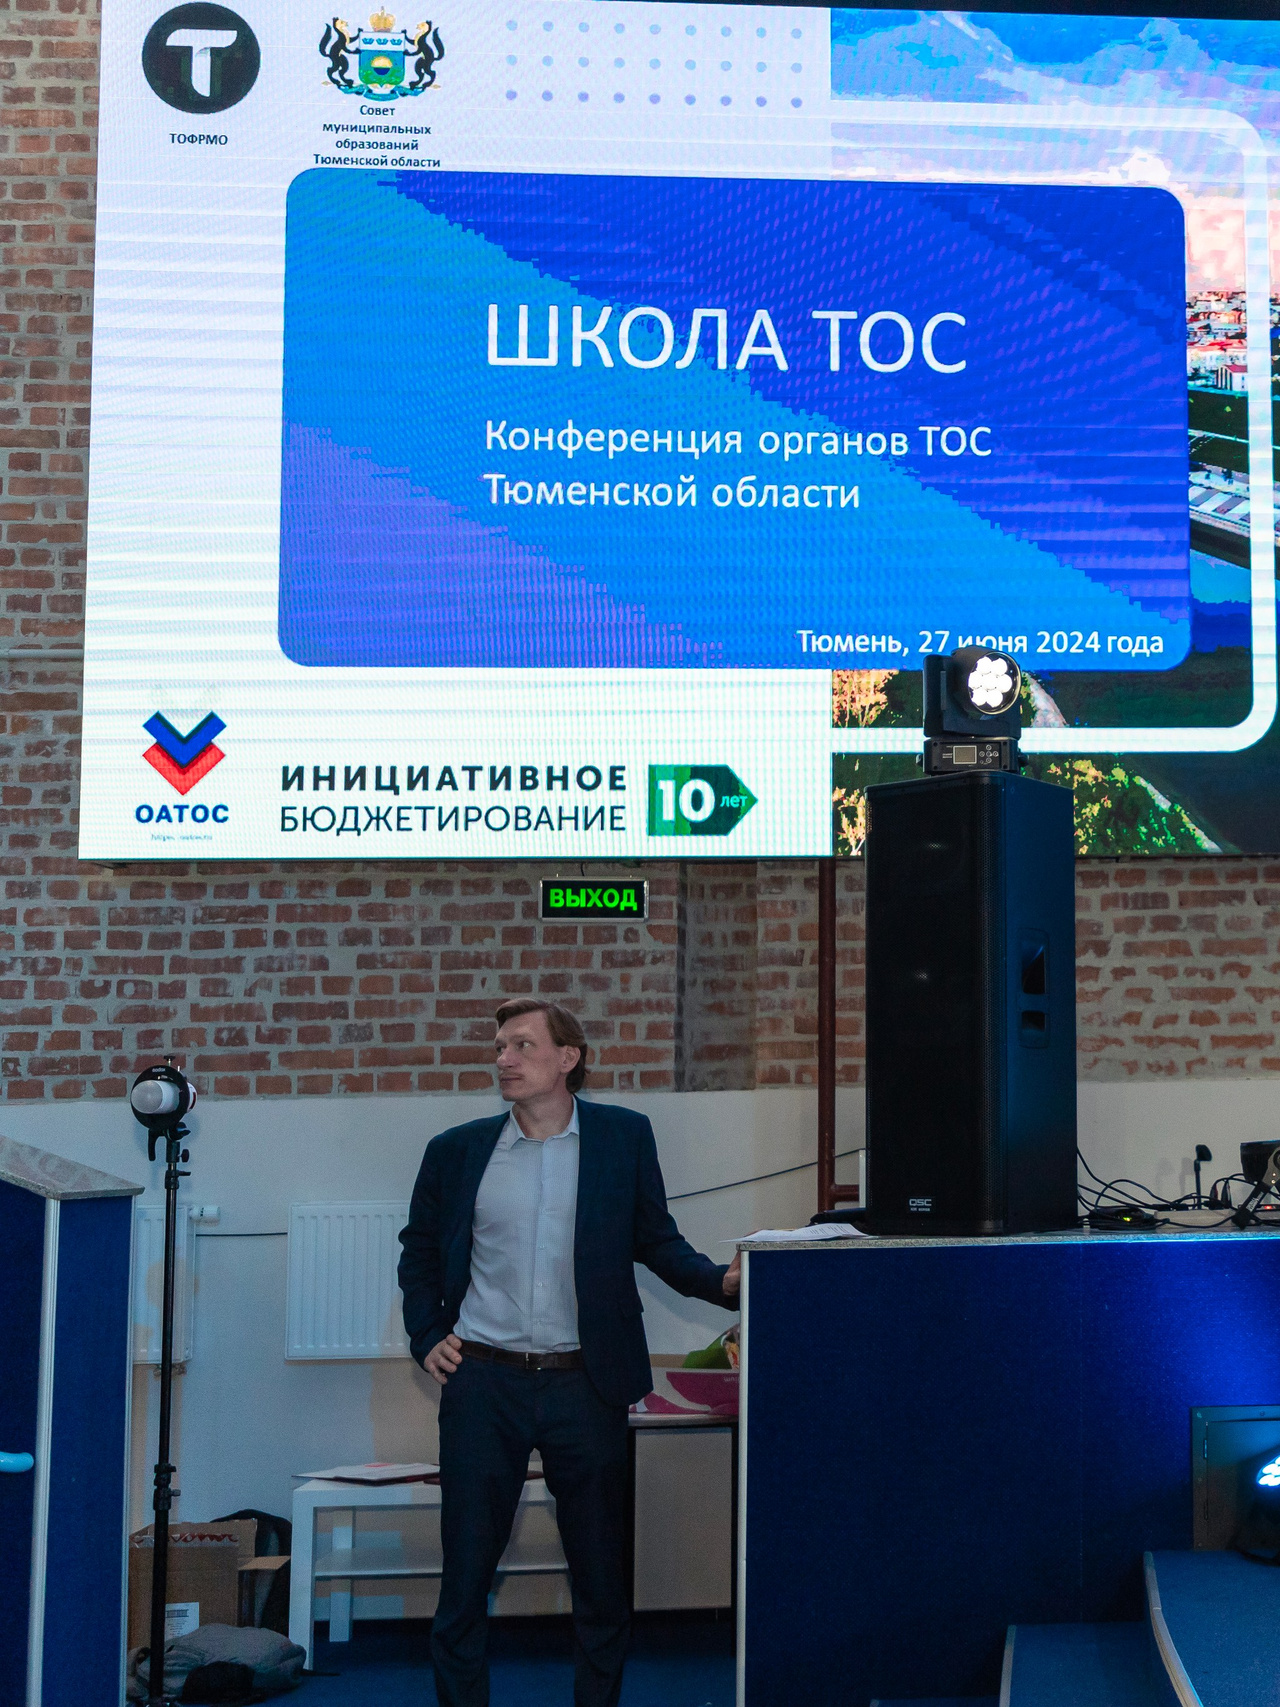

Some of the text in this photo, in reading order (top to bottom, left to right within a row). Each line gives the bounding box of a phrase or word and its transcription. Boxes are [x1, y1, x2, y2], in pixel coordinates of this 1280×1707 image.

[359, 104, 396, 116] Совет
[169, 132, 229, 146] ТОФРМО
[322, 122, 431, 136] муниципальных
[335, 137, 419, 153] образований
[313, 153, 441, 168] Тюменской области
[487, 303, 967, 374] ШКОЛА ТОС
[485, 419, 992, 462] Конференция органов ТОС
[482, 473, 860, 509] Тюменской области
[797, 629, 1164, 657] Тюмень, 27 июня 2024 года
[281, 764, 627, 796] ИНИЦИАТИВНОЕ
[134, 803, 230, 824] ОАТОС
[657, 778, 748, 823] 10 лет
[280, 804, 627, 837] БЮДЖЕТИРОВАНИЕ
[549, 887, 638, 912] ВЫХОД
